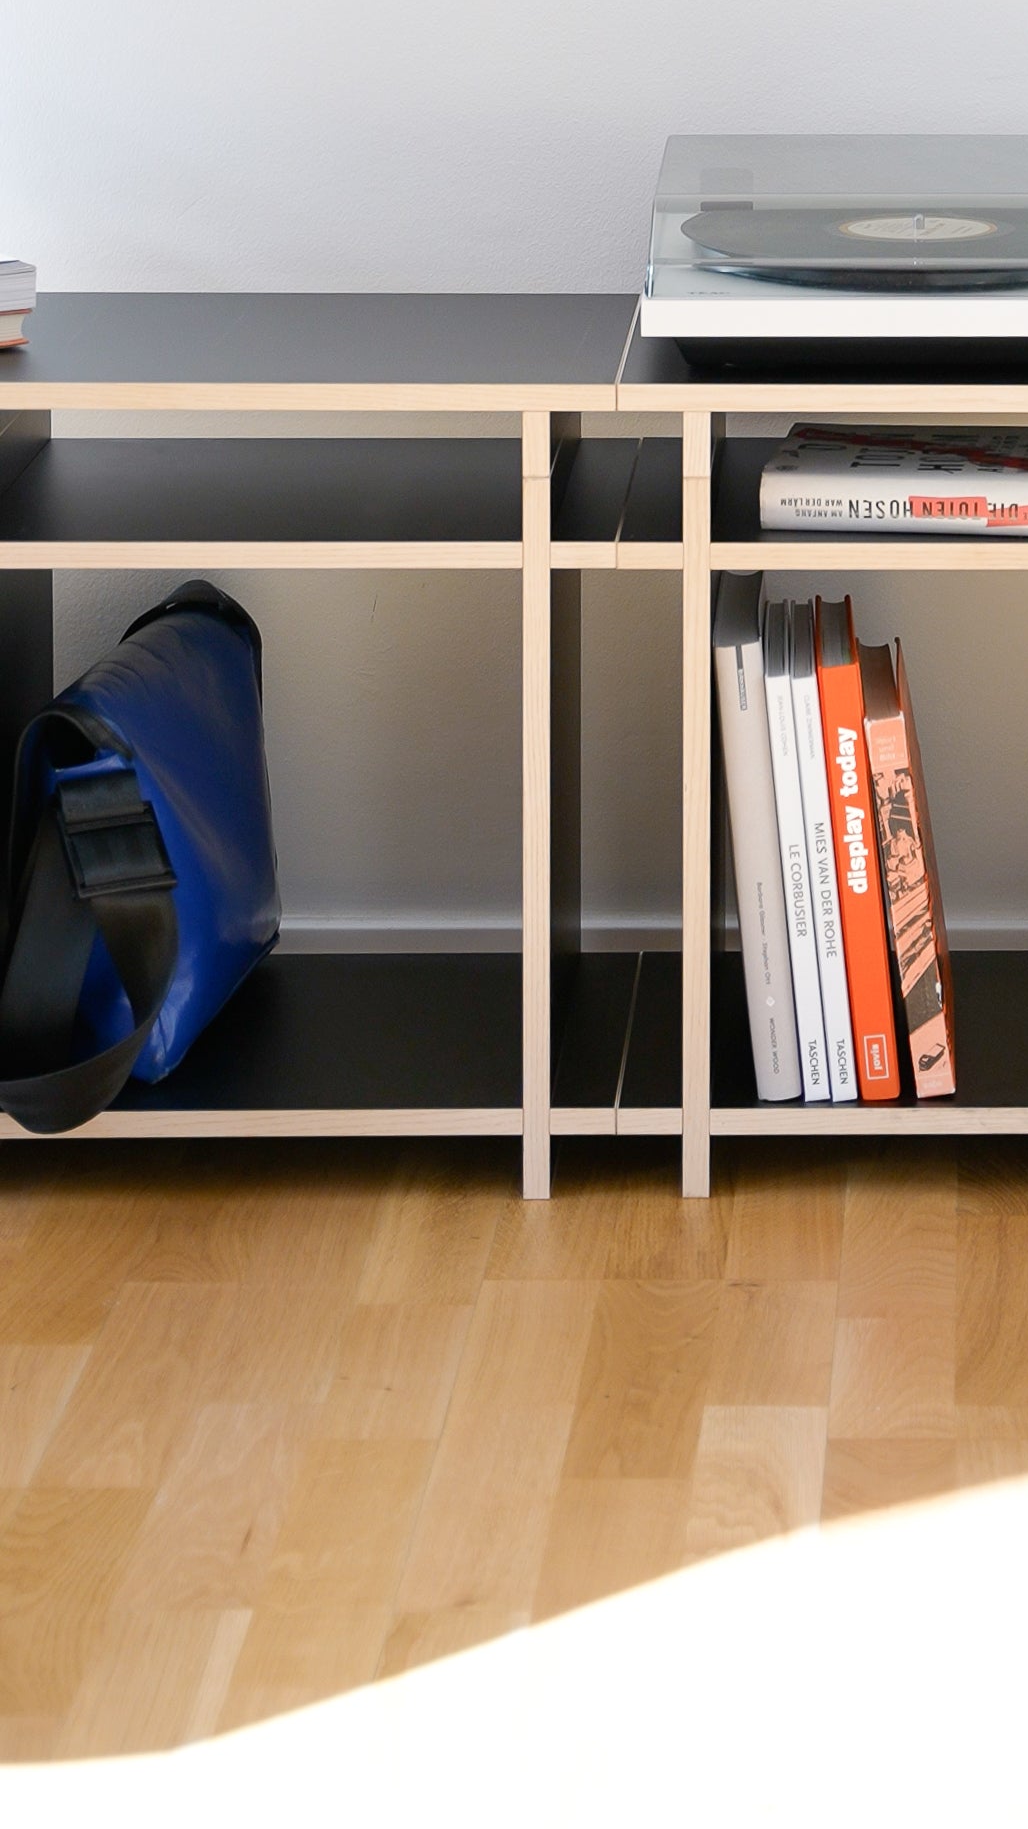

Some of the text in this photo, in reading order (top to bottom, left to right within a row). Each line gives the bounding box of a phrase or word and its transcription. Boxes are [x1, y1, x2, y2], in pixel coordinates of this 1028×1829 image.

[795, 509, 843, 517] AM ANFANG
[805, 498, 822, 506] DER
[825, 499, 843, 507] WAR
[848, 499, 1019, 521] DIE TOTEN HOSEN
[836, 727, 869, 895] display today
[788, 844, 808, 937] LE CORBUSIER
[814, 822, 838, 959] MIES VAN DER ROHE
[808, 1039, 820, 1085] TASCHEN
[836, 1039, 848, 1085] TASCHEN
